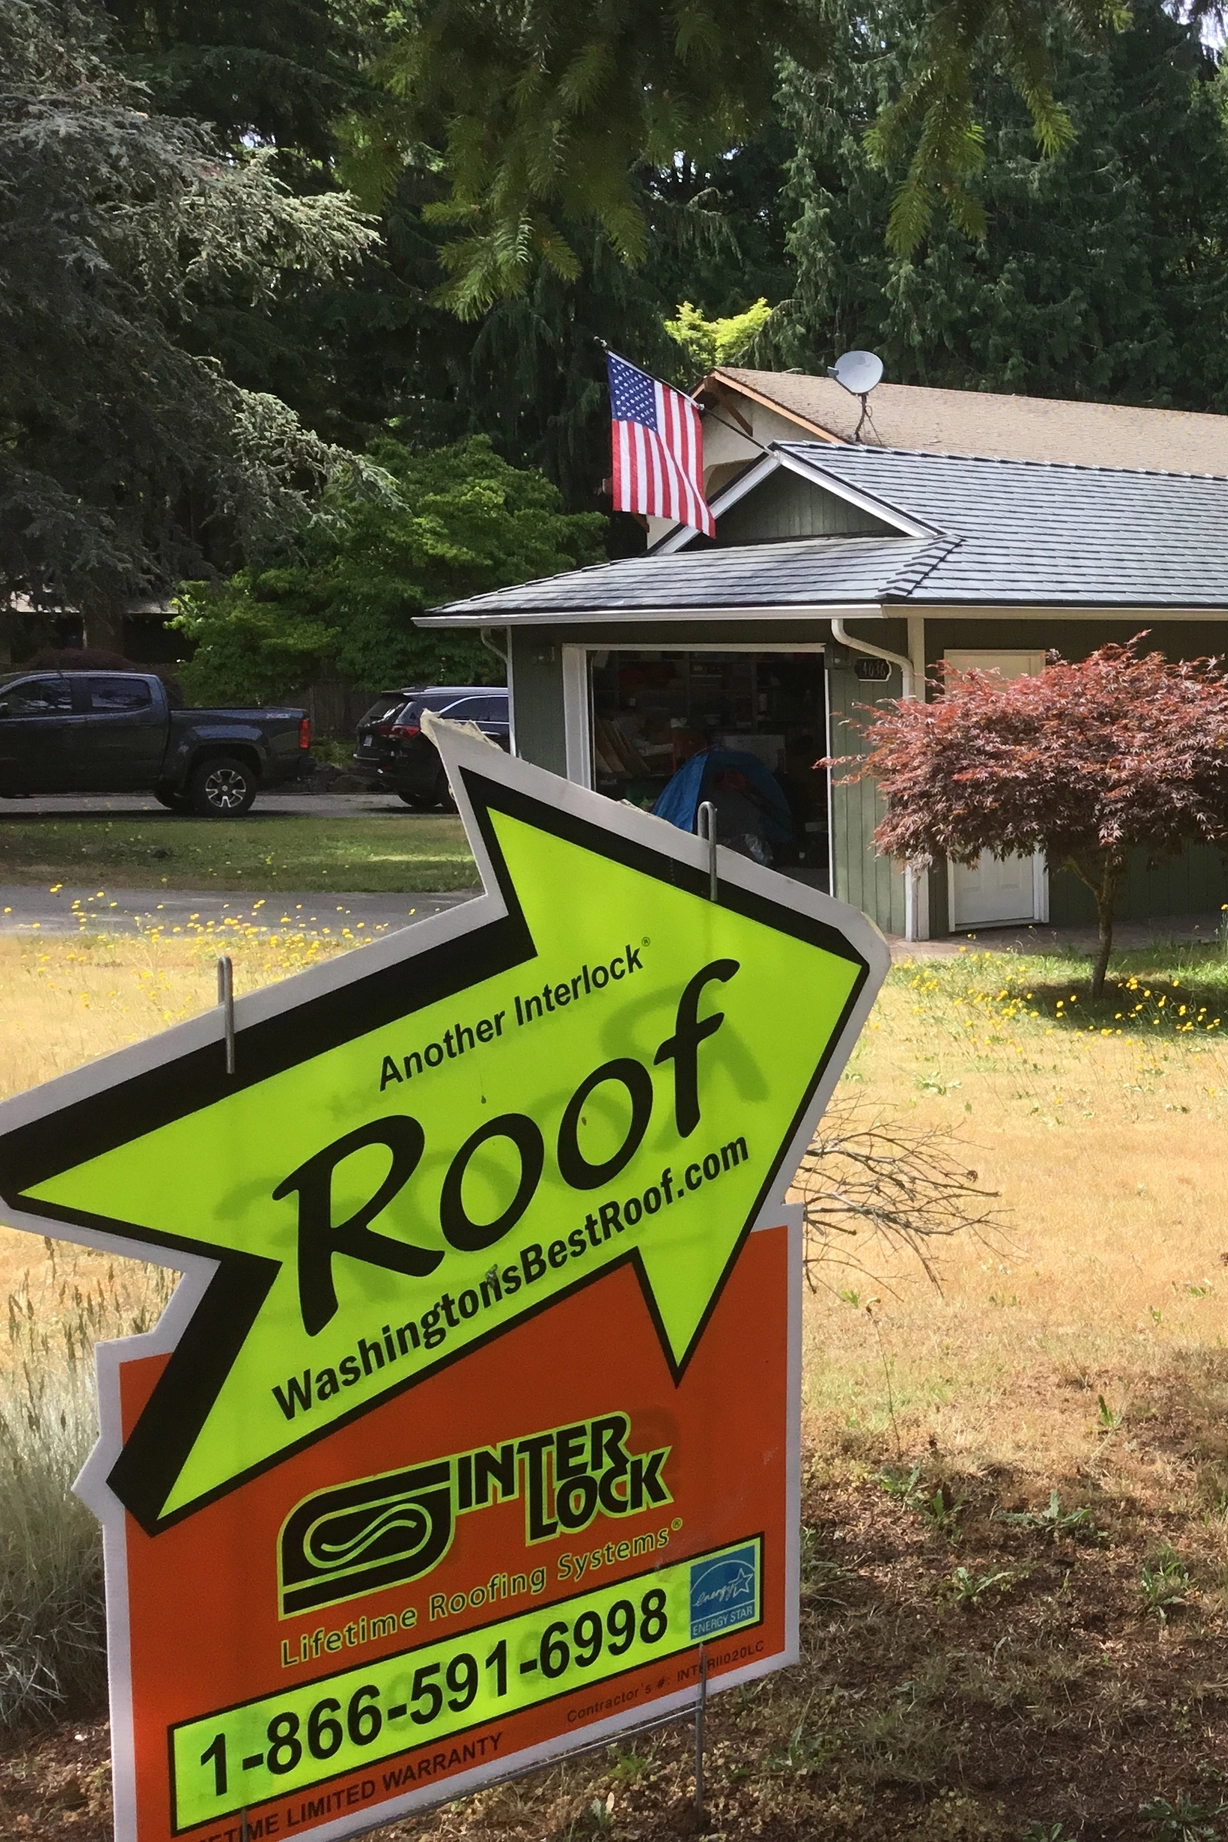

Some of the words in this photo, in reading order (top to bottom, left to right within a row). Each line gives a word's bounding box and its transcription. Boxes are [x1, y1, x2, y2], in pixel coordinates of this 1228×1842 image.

[379, 1010, 506, 1092] Another
[272, 958, 741, 1338] Roof
[271, 1135, 750, 1421] WashingtonsBestRoof.com
[457, 1414, 631, 1511] INTER
[527, 1452, 666, 1543] LOCK
[280, 1606, 418, 1669] Lifetime
[428, 1565, 547, 1622] Roofing
[692, 1614, 729, 1636] ENERGY
[729, 1605, 754, 1623] STAR
[199, 1587, 669, 1798] 1-866-591-6998
[566, 1682, 653, 1723] Contractor's
[286, 1779, 378, 1828] LIMITED
[381, 1730, 505, 1792] WARRANTY
